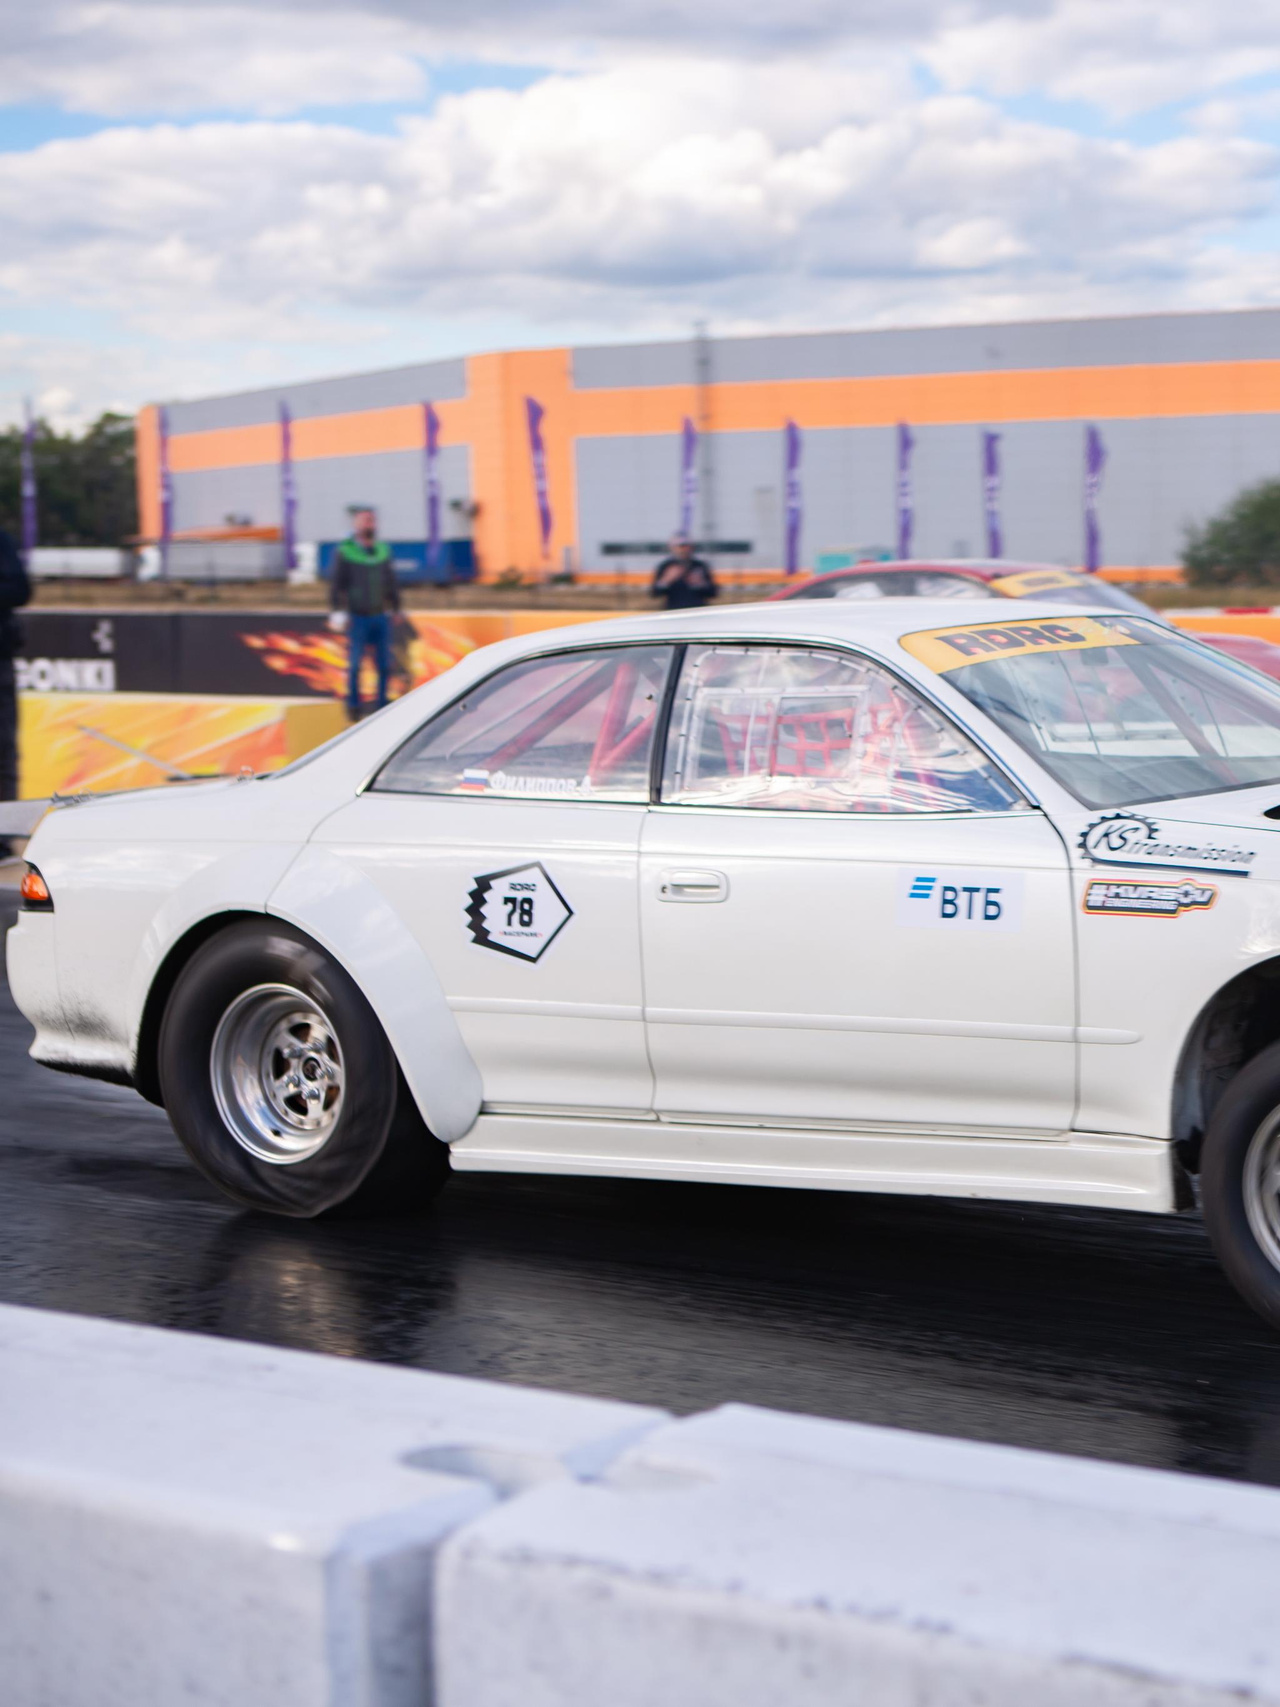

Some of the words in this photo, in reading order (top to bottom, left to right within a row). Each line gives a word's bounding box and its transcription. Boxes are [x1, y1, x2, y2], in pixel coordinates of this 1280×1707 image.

[934, 623, 1086, 657] RDRC
[503, 896, 534, 927] 78
[941, 885, 1002, 921] ВТБ
